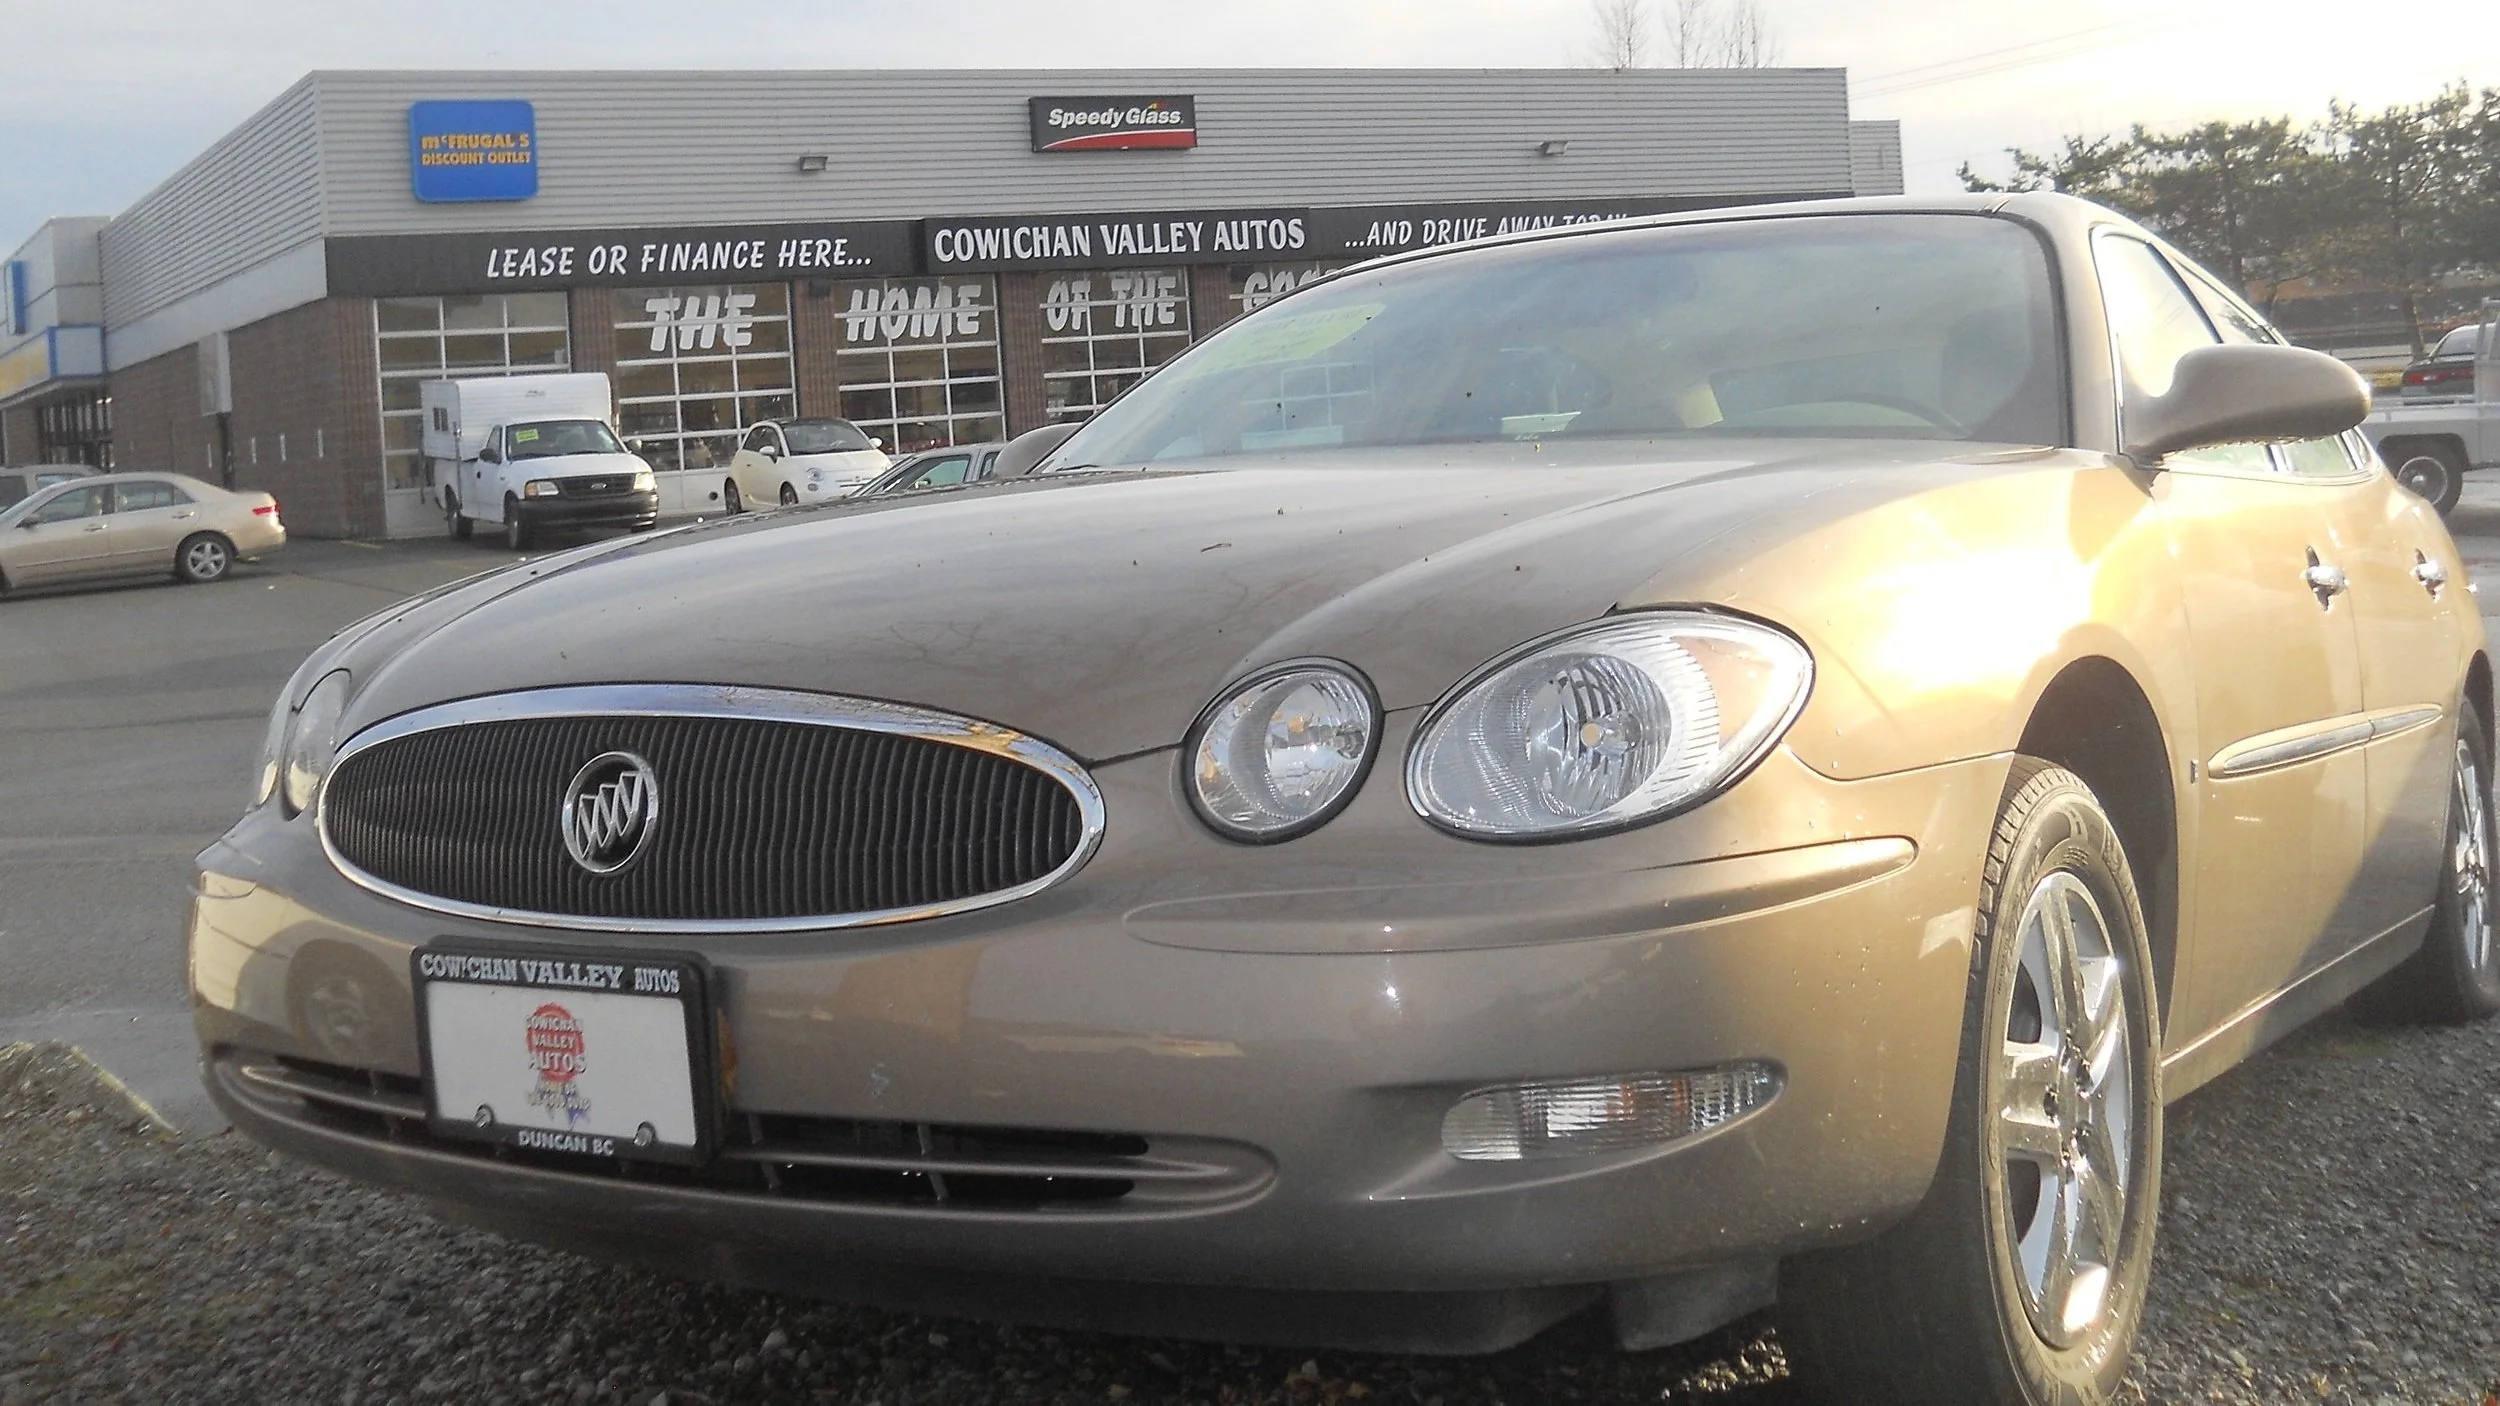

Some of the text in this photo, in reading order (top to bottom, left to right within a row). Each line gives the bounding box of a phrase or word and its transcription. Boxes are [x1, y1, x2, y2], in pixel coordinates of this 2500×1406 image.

[421, 151, 532, 166] DISCOUNT OUTLET
[934, 217, 1306, 262] COWICHAN VALLEY AUTOS
[1422, 217, 1487, 243] DRIVE
[486, 237, 873, 279] LEASE OR FINANCE HERE...
[645, 293, 756, 352] THE
[846, 284, 982, 342] HOME
[1046, 278, 1092, 332] OF
[1110, 275, 1177, 329] THE
[519, 959, 624, 989] VALLEY
[633, 966, 681, 994] AUTOS
[534, 1033, 577, 1050] VALLEY
[528, 1050, 587, 1074] AUTOS
[518, 1130, 615, 1156] DUNCAN BC
